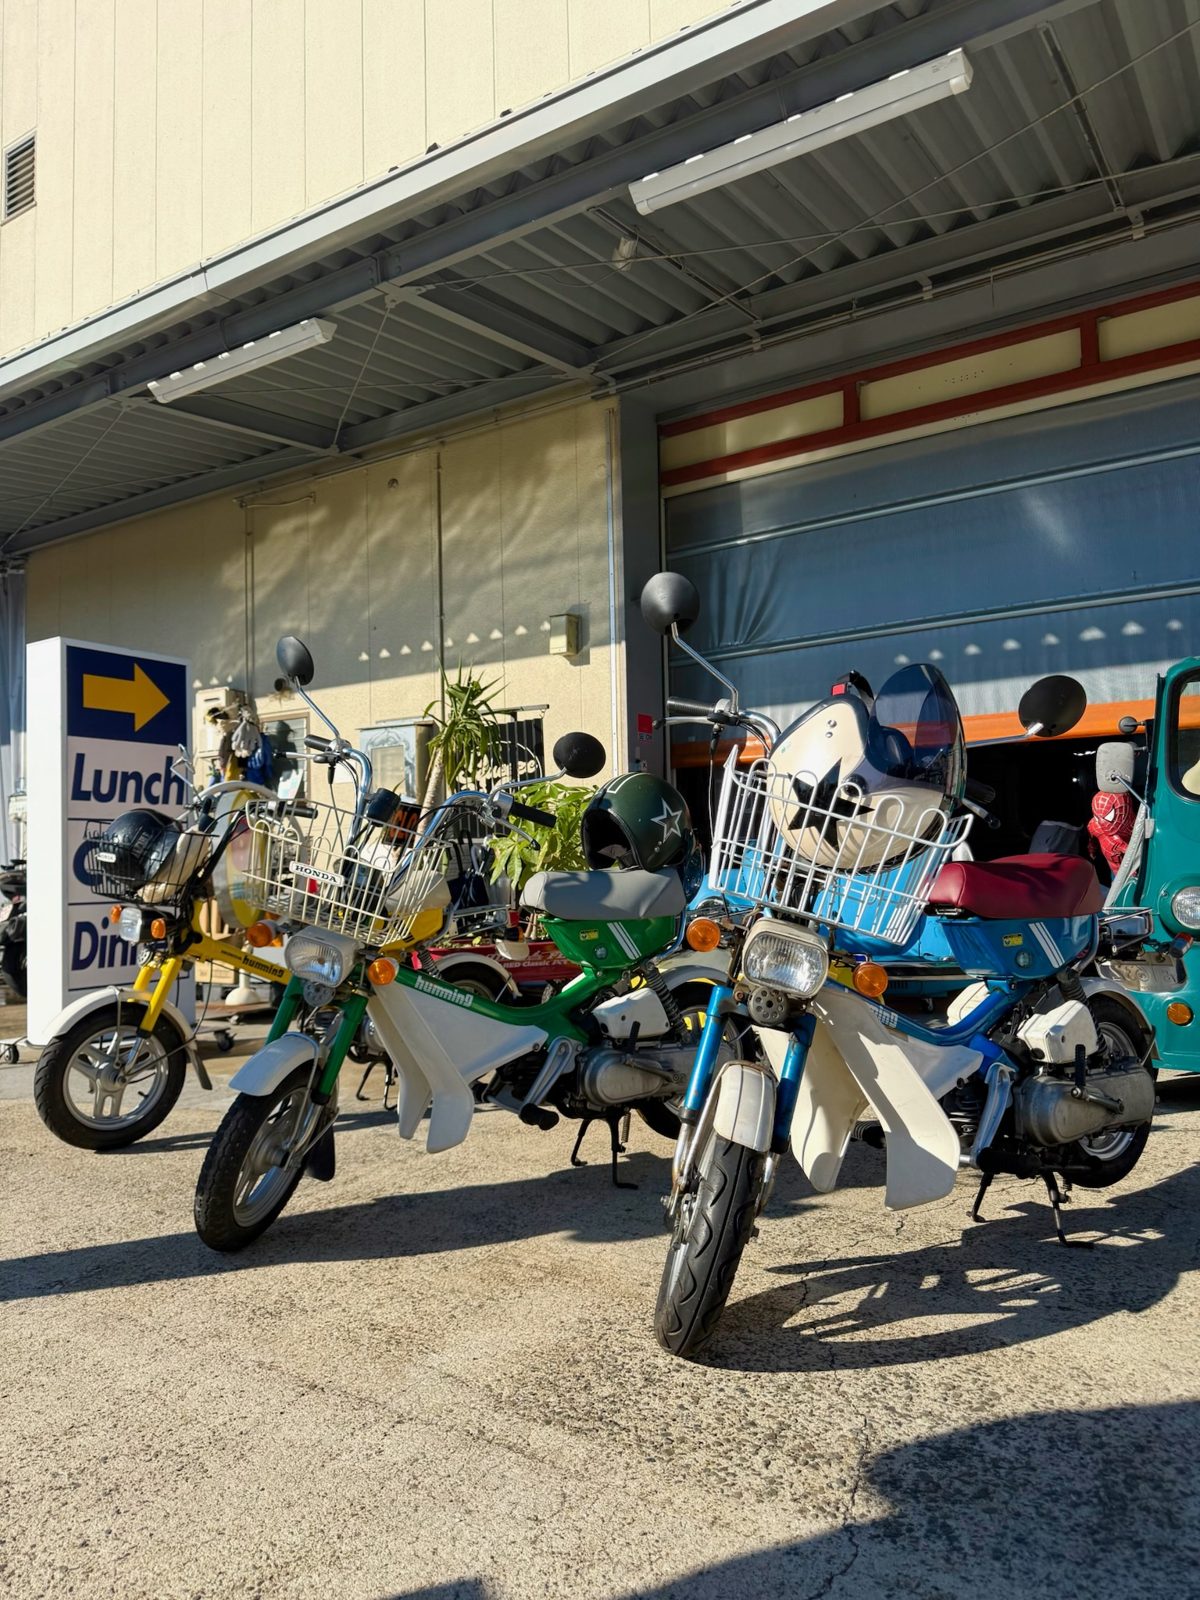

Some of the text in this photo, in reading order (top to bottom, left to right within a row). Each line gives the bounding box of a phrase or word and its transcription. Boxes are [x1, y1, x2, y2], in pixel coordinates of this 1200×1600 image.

[71, 752, 185, 806] Lunch
[295, 864, 337, 883] HONDA
[242, 954, 285, 978] humming
[414, 975, 474, 1008] humming
